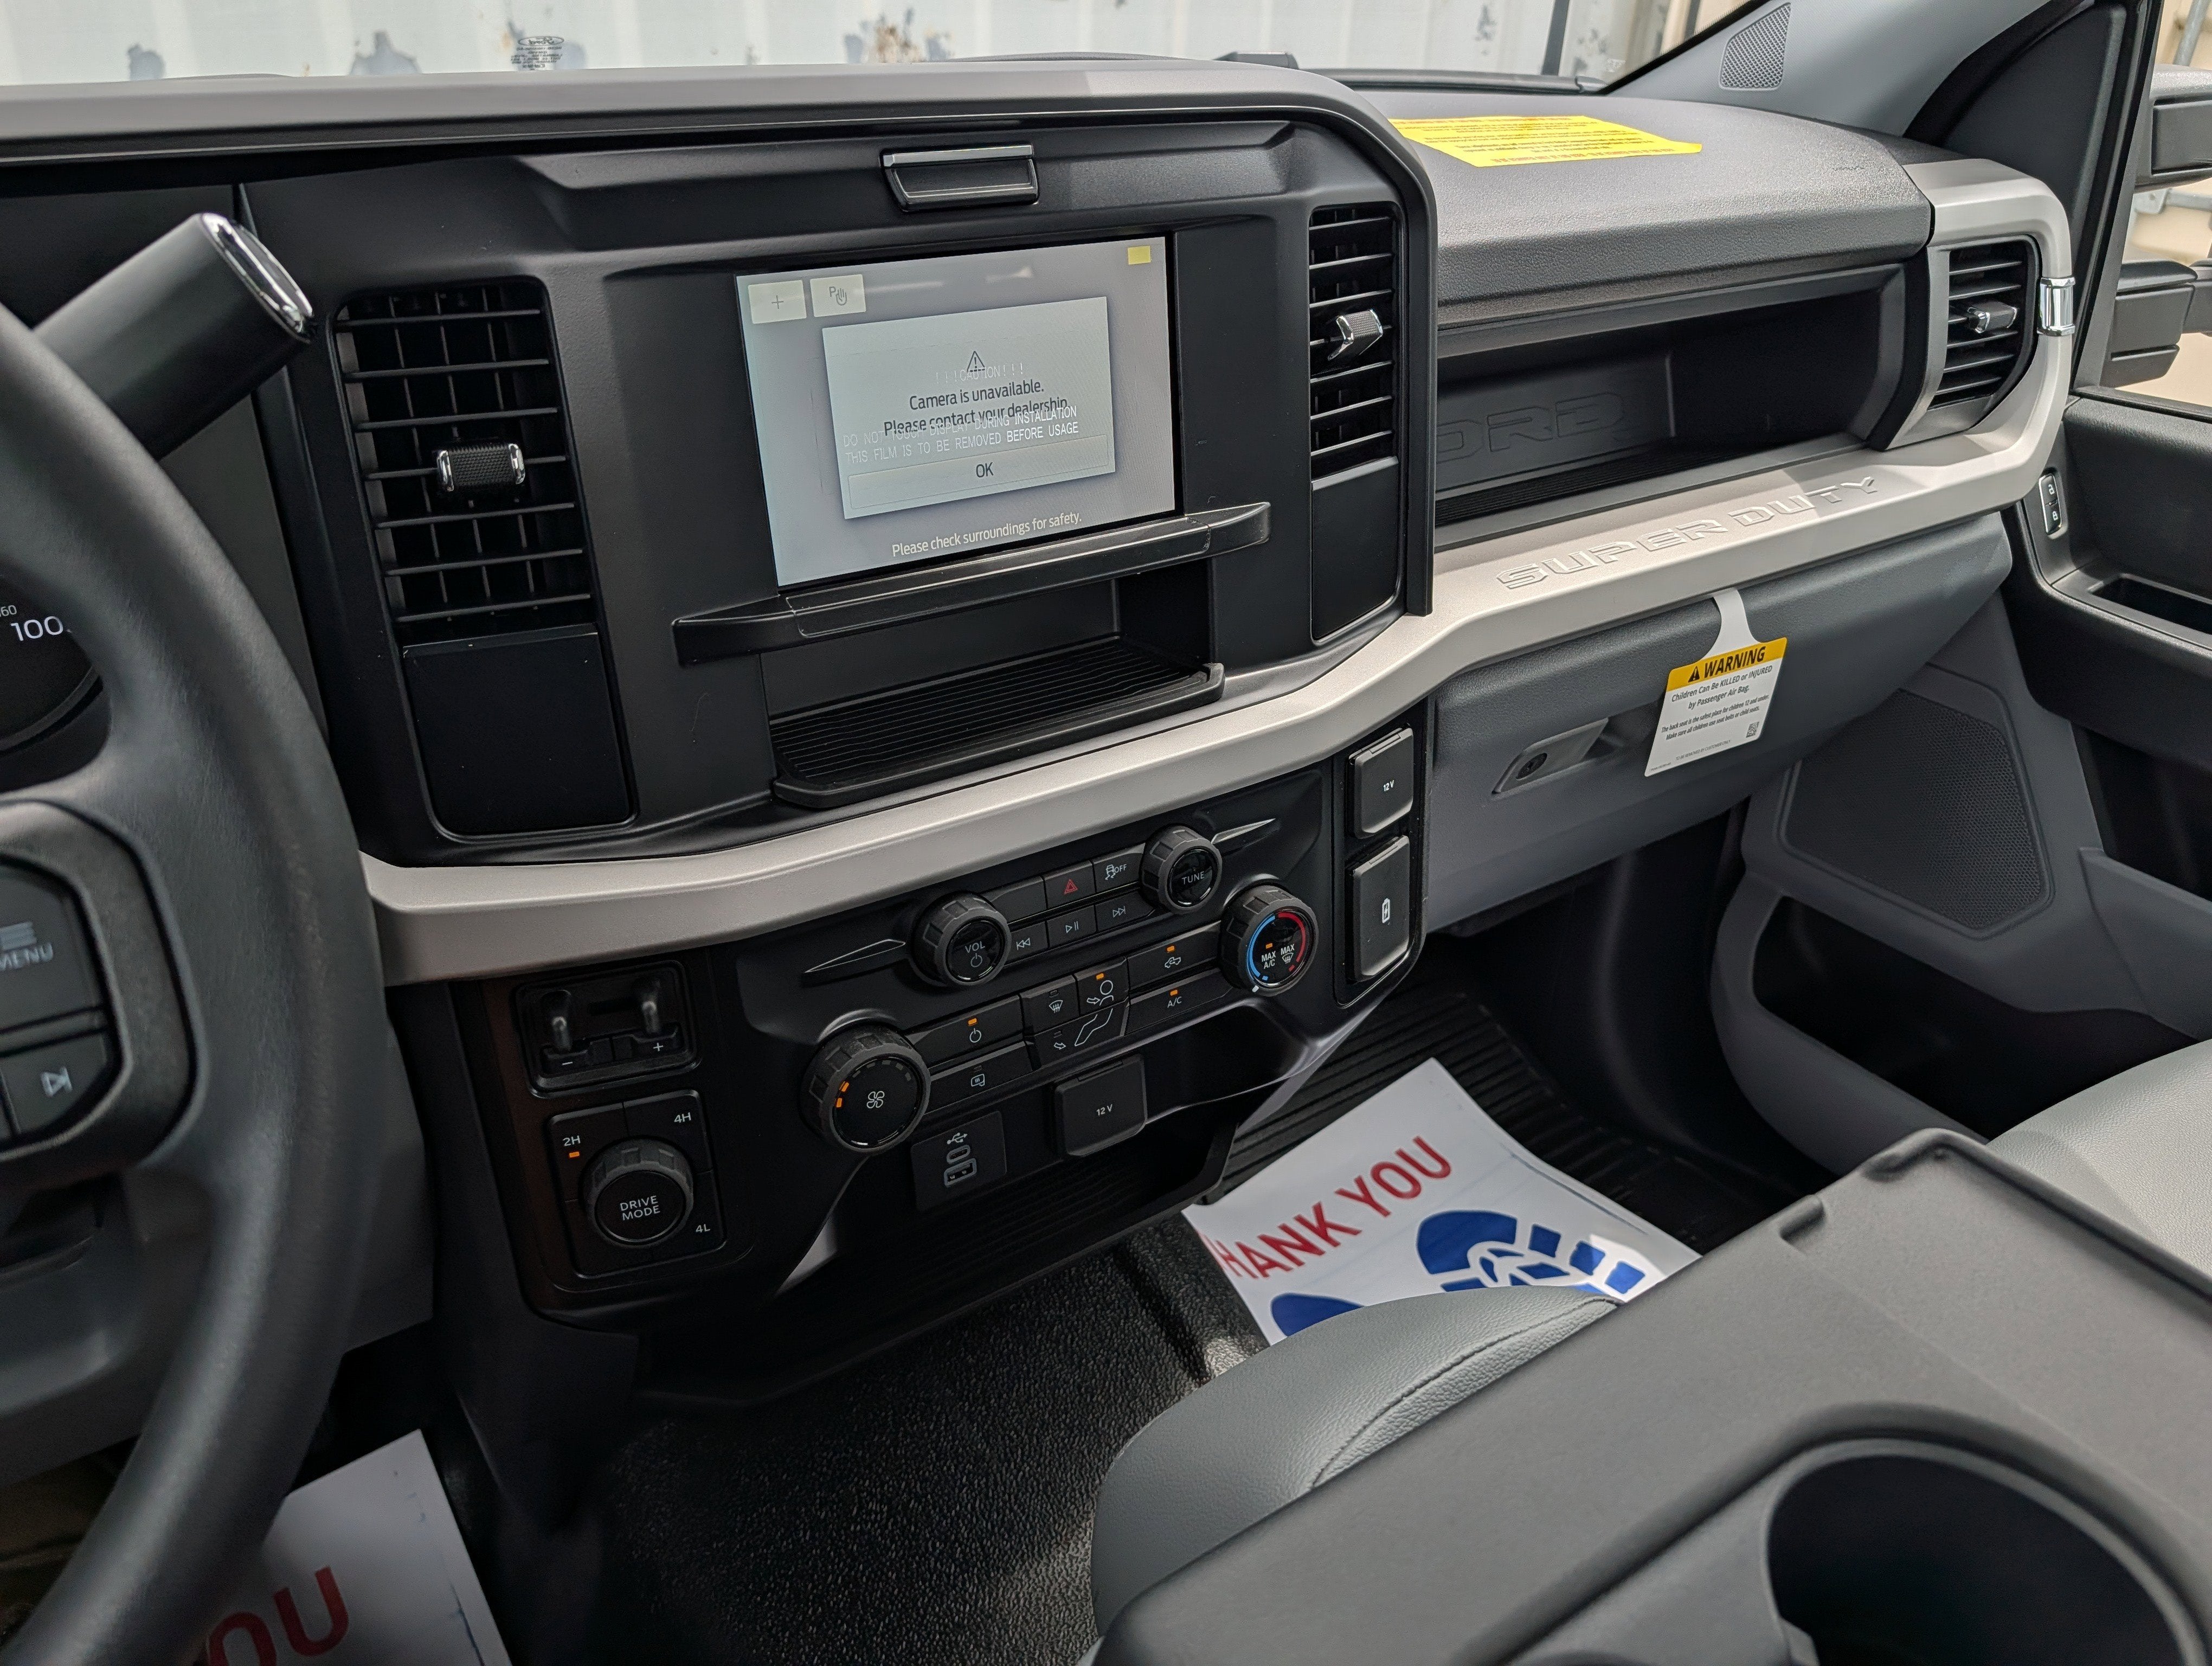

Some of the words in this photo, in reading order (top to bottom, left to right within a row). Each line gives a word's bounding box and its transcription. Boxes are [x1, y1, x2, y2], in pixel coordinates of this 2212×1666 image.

[910, 393, 958, 411] Camera
[960, 389, 970, 403] is
[972, 379, 1044, 401] unavailable.
[844, 434, 858, 447] DO
[864, 430, 884, 445] NOT
[975, 414, 1009, 430] DURING
[1014, 406, 1077, 425] INSTALLATION
[884, 419, 927, 437] Please
[929, 409, 975, 430] contact
[978, 408, 1005, 425] your
[1437, 392, 1625, 464] ORD
[845, 450, 868, 464] THIS
[874, 446, 897, 460] FILM
[902, 444, 912, 457] IS
[917, 441, 931, 454] TO
[936, 439, 950, 452] BE
[955, 432, 1001, 450] REMOVED
[1007, 426, 1044, 443] BEFORE
[1049, 421, 1078, 437] USAGE
[976, 462, 994, 478] OK
[892, 542, 929, 557] Please
[930, 533, 962, 550] check
[963, 521, 1030, 544] surroundings
[1032, 517, 1047, 531] for
[1049, 512, 1082, 528] safety.
[1496, 518, 1728, 589] SUPER
[1728, 476, 1879, 527] DUTY
[0, 605, 17, 617] 60
[10, 616, 63, 641] 100
[1704, 646, 1765, 678] WARNING
[1671, 689, 1697, 702] Children
[1698, 685, 1710, 694] Can
[1719, 675, 1740, 687] KILLED
[1740, 673, 1748, 681] or
[1748, 665, 1773, 678] INJURED
[1688, 701, 1696, 710] by
[1696, 692, 1727, 706] Passenger
[1727, 688, 1737, 697] Air
[1114, 863, 1127, 874] OFF
[1181, 870, 1205, 885] TUNE
[965, 940, 986, 953] VOL
[1281, 943, 1295, 956] MAX
[1261, 950, 1276, 962] MAX
[1263, 959, 1275, 970] A/C
[1167, 996, 1182, 1008] A/C
[673, 1112, 692, 1123] 4H
[563, 1135, 581, 1146] 2H
[620, 1195, 658, 1212] DRIVE
[1197, 1201, 1362, 1279] HANK
[1334, 1136, 1452, 1218] YOU
[622, 1204, 660, 1221] MODE
[695, 1223, 711, 1233] 4L
[208, 1565, 349, 1666] OU
